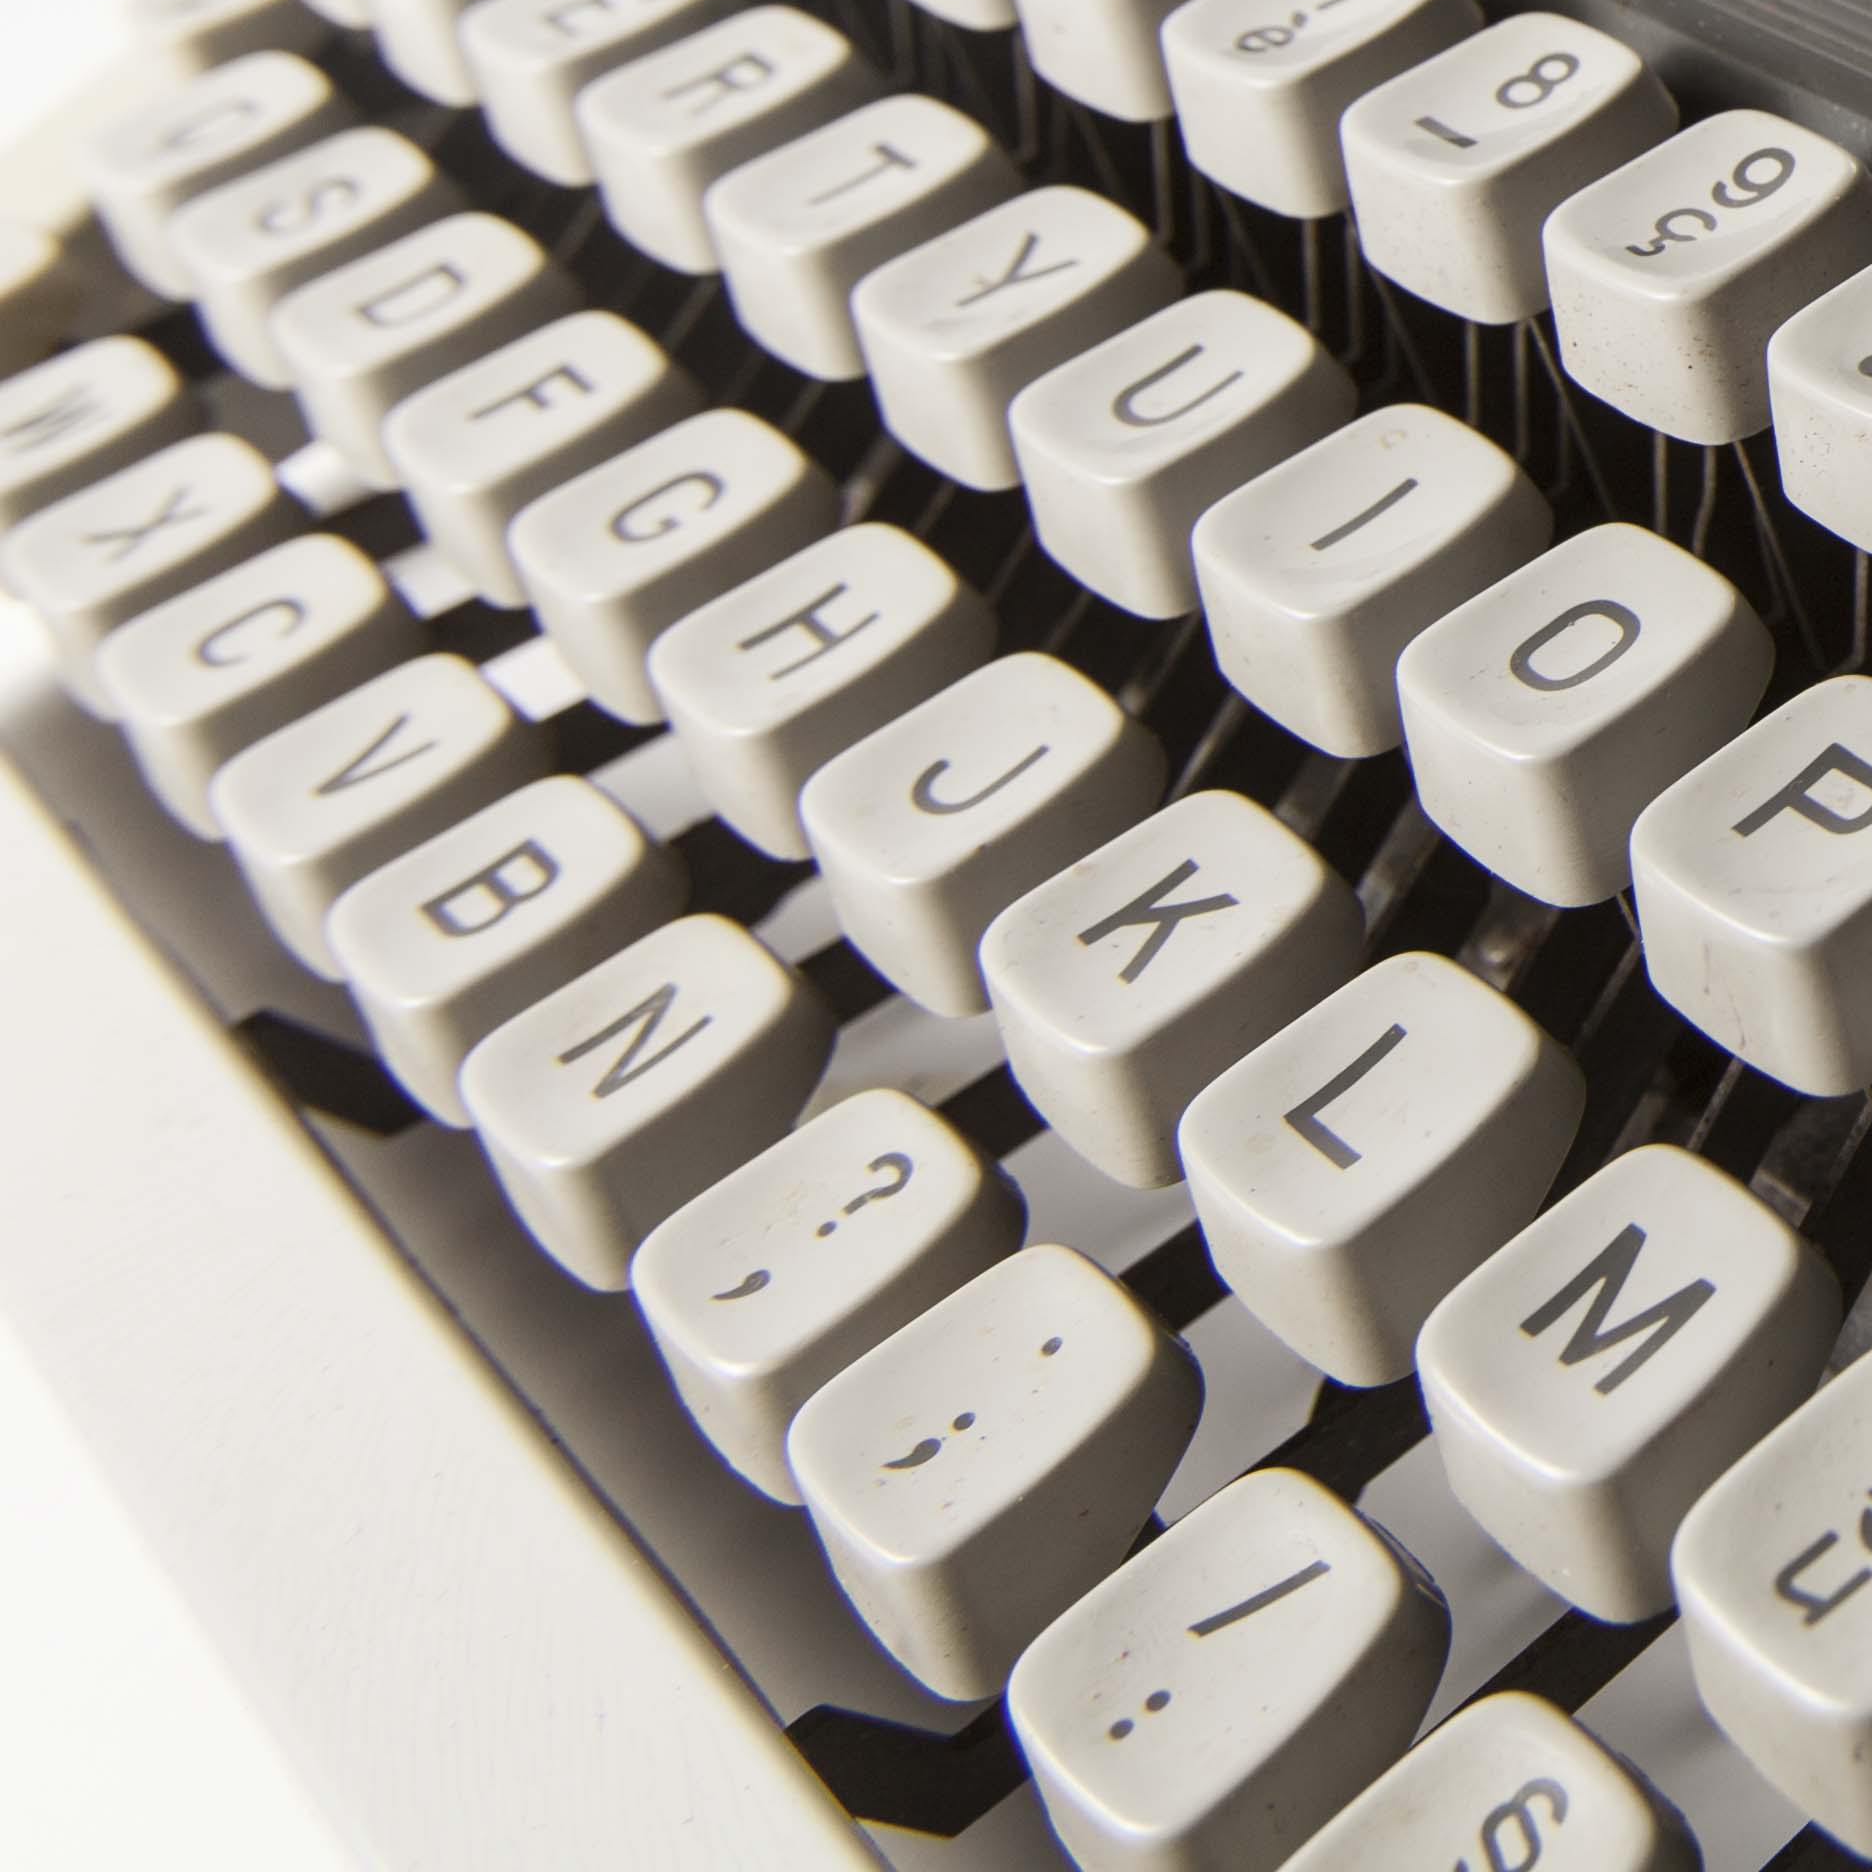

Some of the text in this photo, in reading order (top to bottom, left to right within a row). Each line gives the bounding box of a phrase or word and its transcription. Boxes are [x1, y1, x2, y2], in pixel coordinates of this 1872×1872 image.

[1234, 12, 1308, 55] è
[659, 52, 775, 118] R
[1495, 52, 1580, 110] 8
[255, 177, 360, 236] S
[811, 142, 917, 206] T
[1711, 146, 1796, 209] 9
[1625, 207, 1718, 258] ç
[352, 262, 468, 330] D
[956, 232, 1080, 308] Y
[465, 361, 595, 422] F
[1112, 343, 1245, 428] U
[80, 485, 210, 563] X
[608, 471, 726, 543] G
[1310, 477, 1419, 551] I
[197, 597, 307, 669] C
[735, 580, 880, 680] H
[1509, 599, 1642, 692] O
[311, 711, 438, 799] V
[911, 744, 1051, 816] J
[418, 838, 563, 938] B
[1077, 858, 1240, 984] K
[555, 982, 713, 1099] N
[1283, 1023, 1407, 1170] L
[816, 1151, 914, 1238] ?
[1519, 1223, 1717, 1396] M
[881, 1411, 976, 1470] ;
[1108, 1689, 1171, 1741] :
